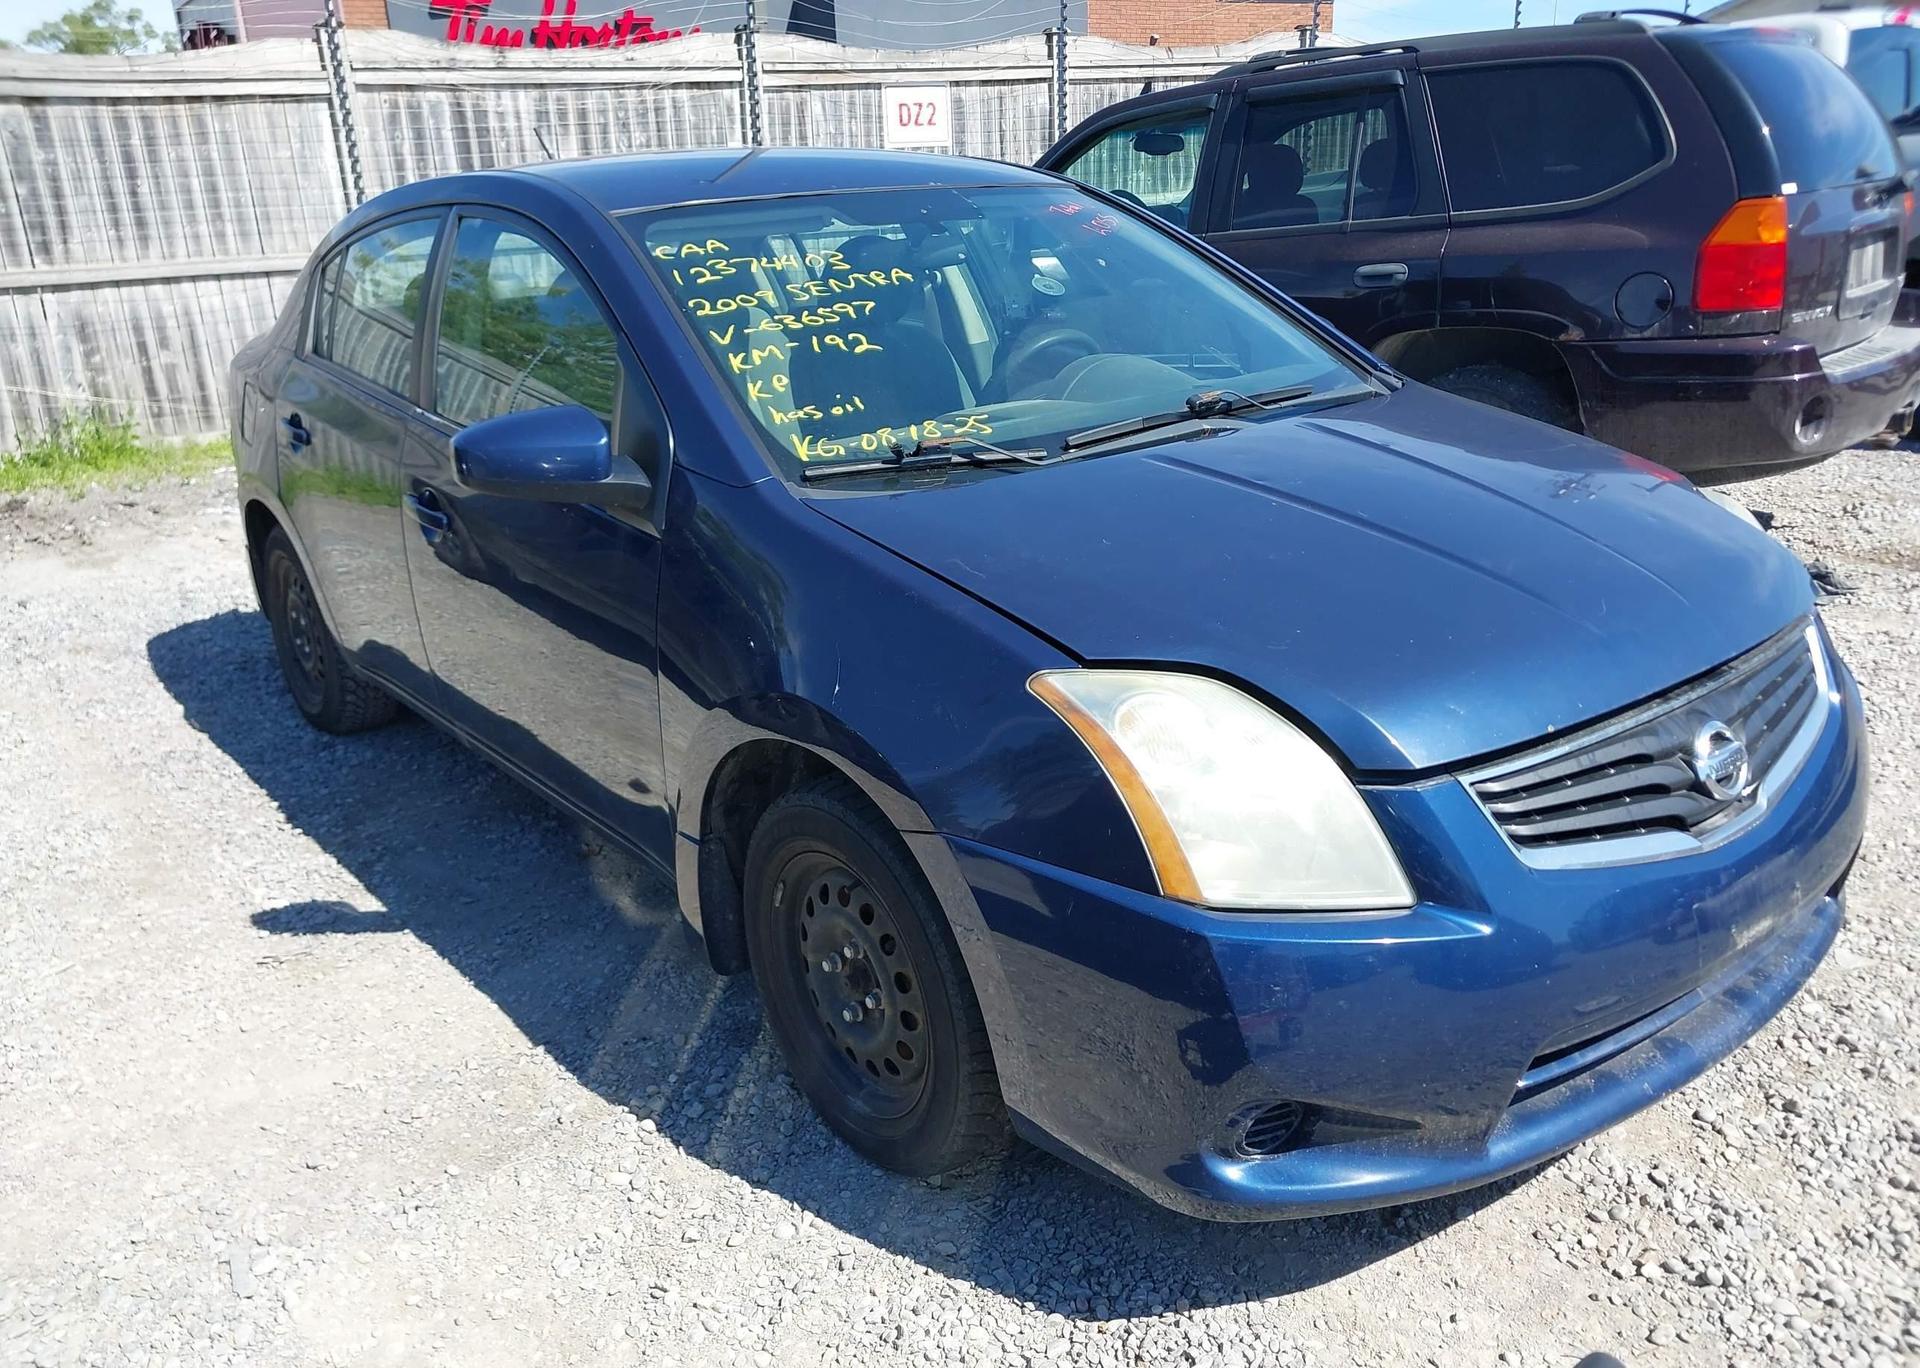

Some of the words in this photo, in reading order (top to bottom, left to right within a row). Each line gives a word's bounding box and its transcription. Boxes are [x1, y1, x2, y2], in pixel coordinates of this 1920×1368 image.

[430, 0, 524, 48] Tim
[530, 0, 701, 49] Horto
[898, 102, 937, 127] DZ2
[654, 239, 730, 260] CAA
[672, 249, 852, 286] 12374403
[688, 290, 777, 316] 2009
[785, 267, 914, 301] SENTRA
[768, 405, 823, 425] has
[830, 394, 865, 415] oil
